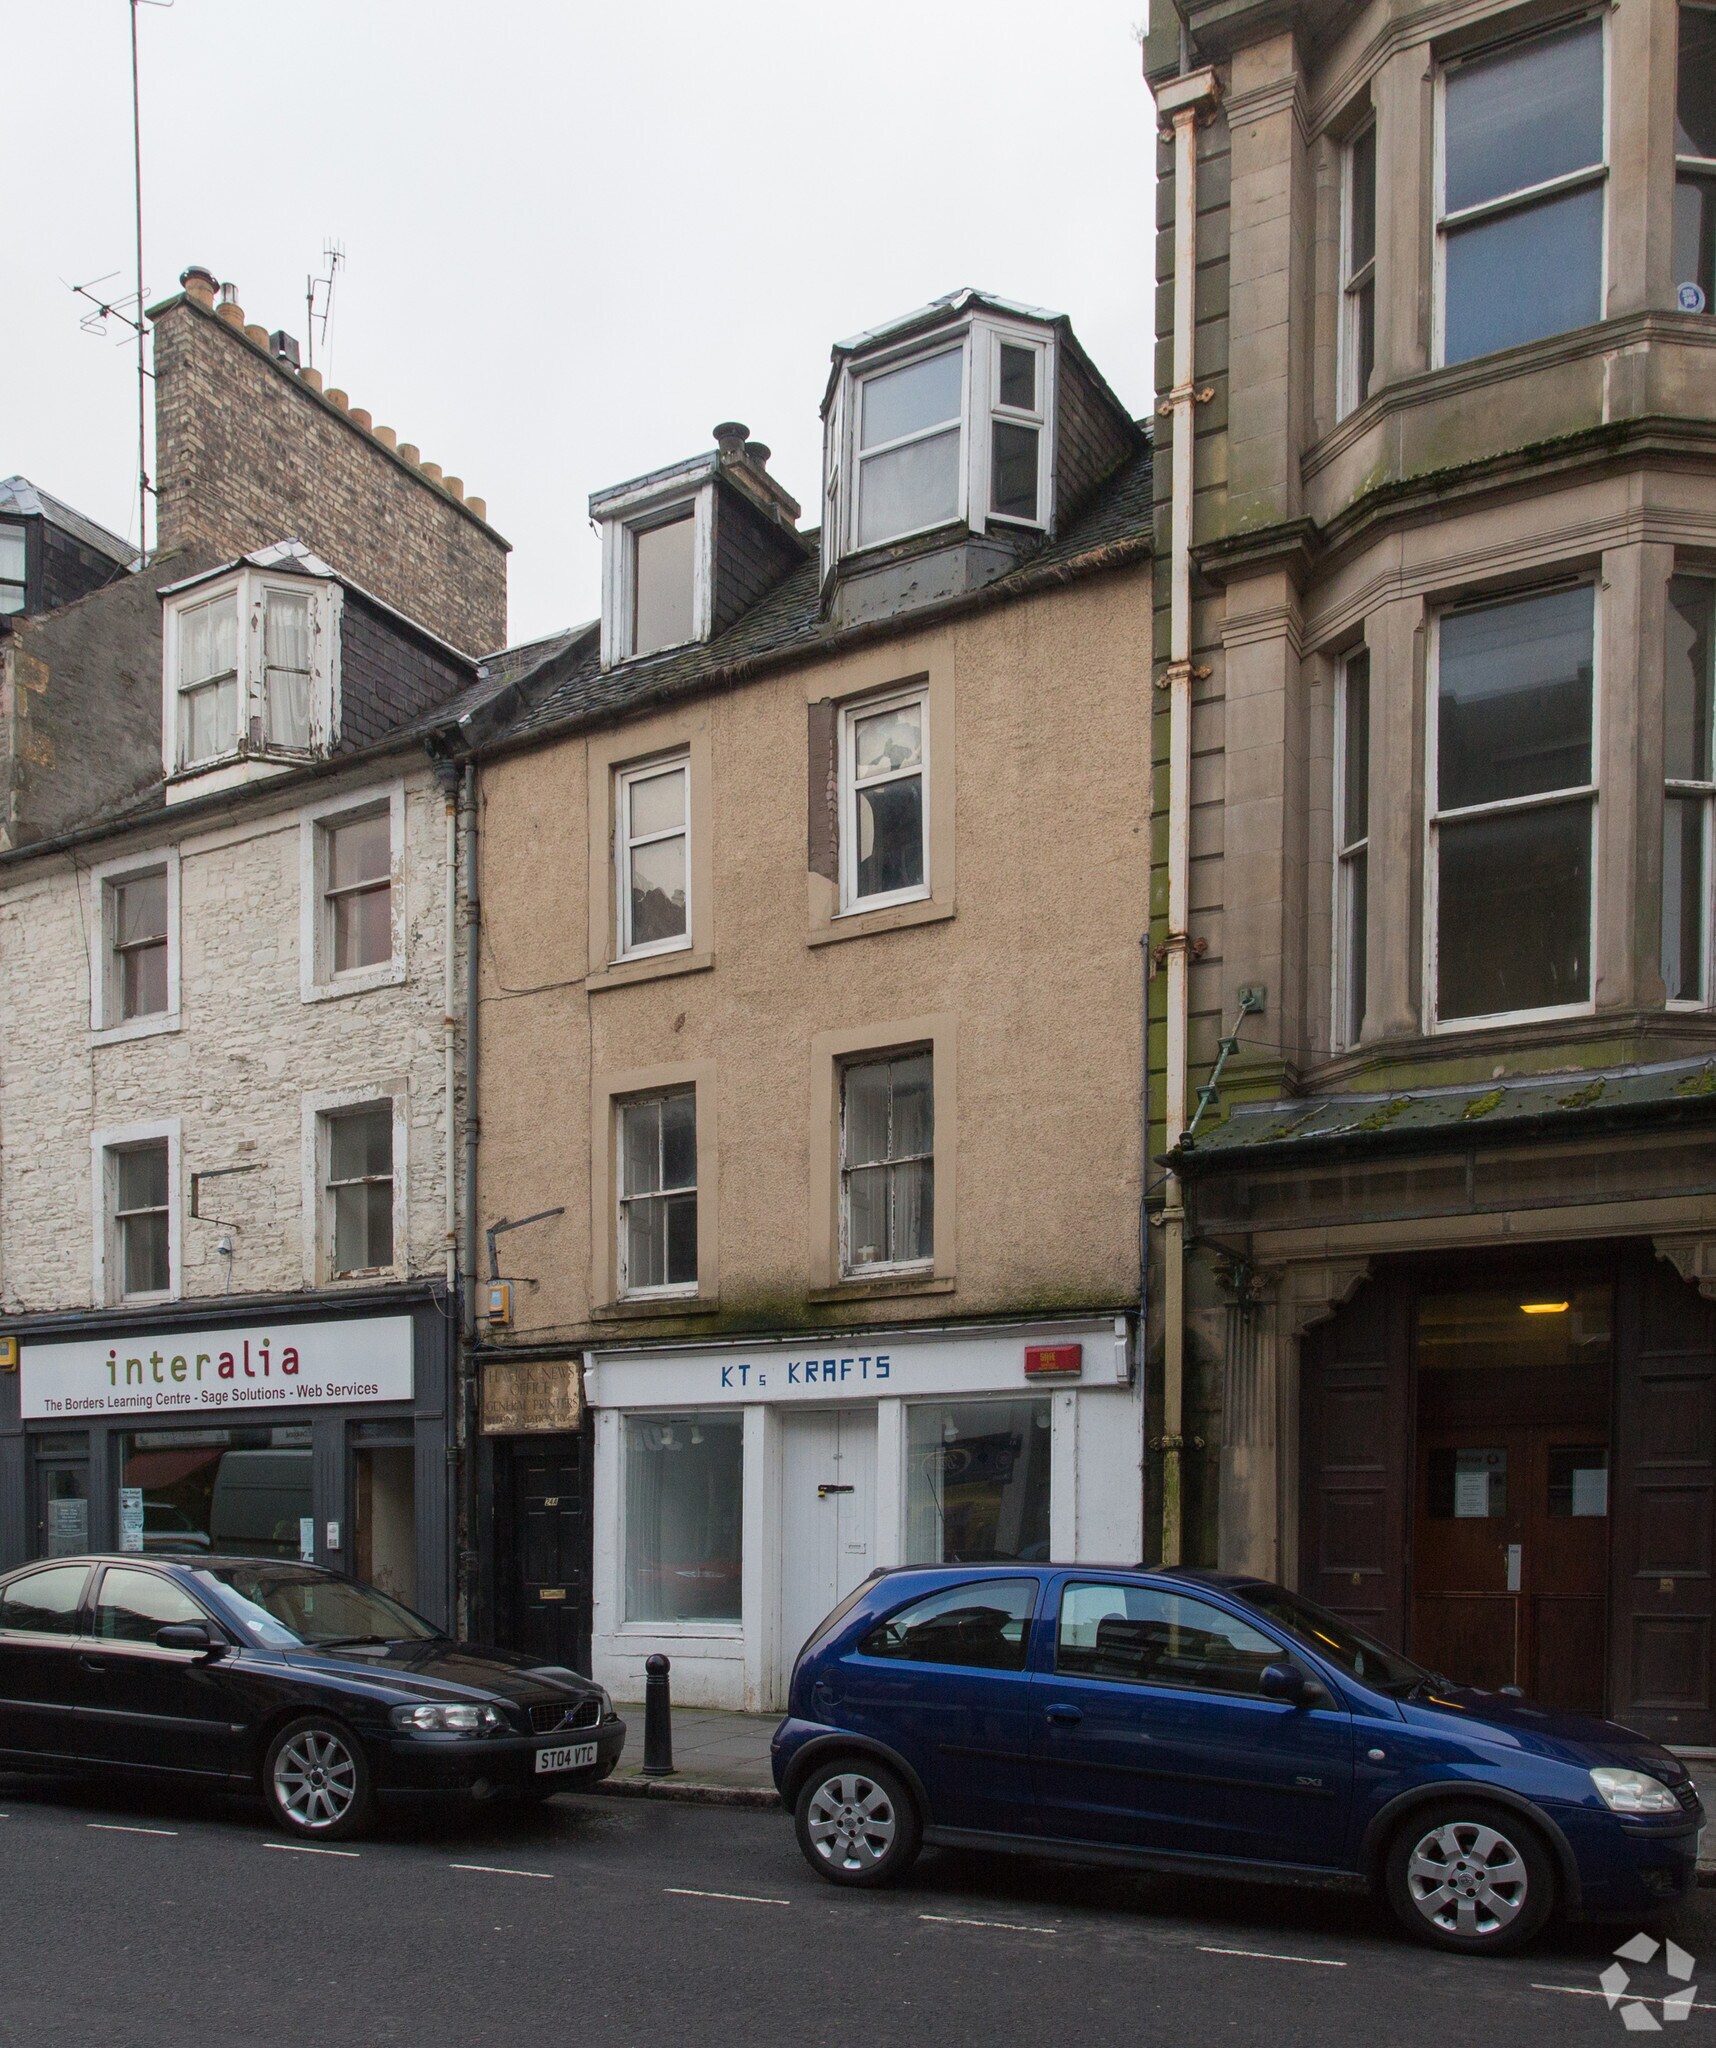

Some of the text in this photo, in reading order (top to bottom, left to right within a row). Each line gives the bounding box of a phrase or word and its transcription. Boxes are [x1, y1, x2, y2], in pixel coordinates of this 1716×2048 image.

[105, 1338, 299, 1386] interalia
[488, 1365, 576, 1383] HWICK NEWS
[788, 1355, 890, 1383] KRAFTS
[44, 1399, 63, 1412] The
[65, 1396, 105, 1411] Borders
[107, 1393, 153, 1409] Learning
[155, 1391, 191, 1405] Centre
[201, 1389, 229, 1405] Sage
[231, 1386, 286, 1401] Solutions
[296, 1383, 323, 1398] Web
[326, 1381, 378, 1396] Services
[509, 1380, 551, 1397] OFFICE
[486, 1396, 578, 1412] GENERAL PRINTERS
[541, 1745, 594, 1770] ST04 VTC
